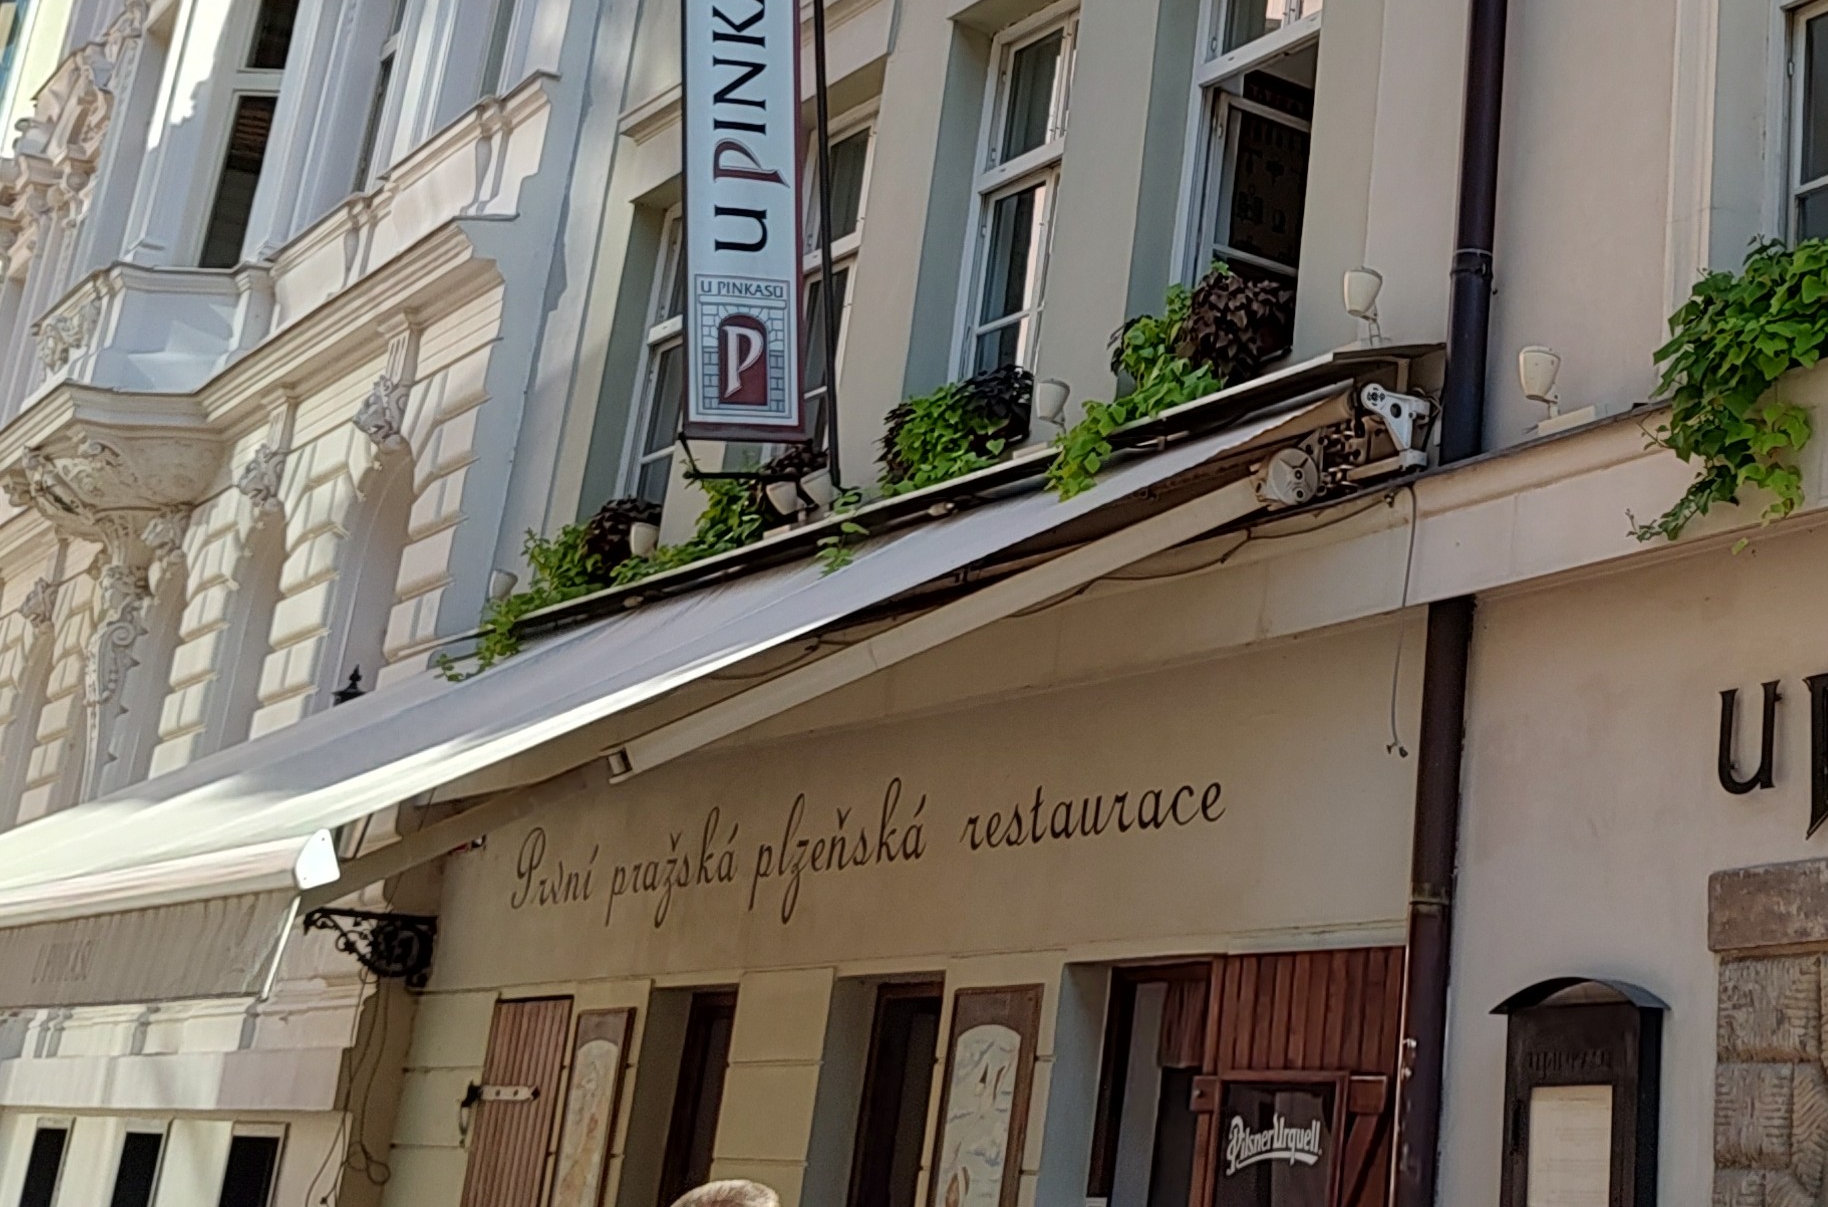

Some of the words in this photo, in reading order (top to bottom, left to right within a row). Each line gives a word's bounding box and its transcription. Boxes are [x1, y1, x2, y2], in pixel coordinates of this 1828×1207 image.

[714, 204, 768, 253] U
[700, 280, 712, 293] U
[721, 324, 765, 399] P
[1717, 678, 1781, 795] U
[510, 827, 599, 910] První
[605, 805, 739, 929] pražská
[748, 777, 928, 925] plzeňská
[960, 782, 1226, 851] restaurace
[1226, 1115, 1275, 1176] Pilsner
